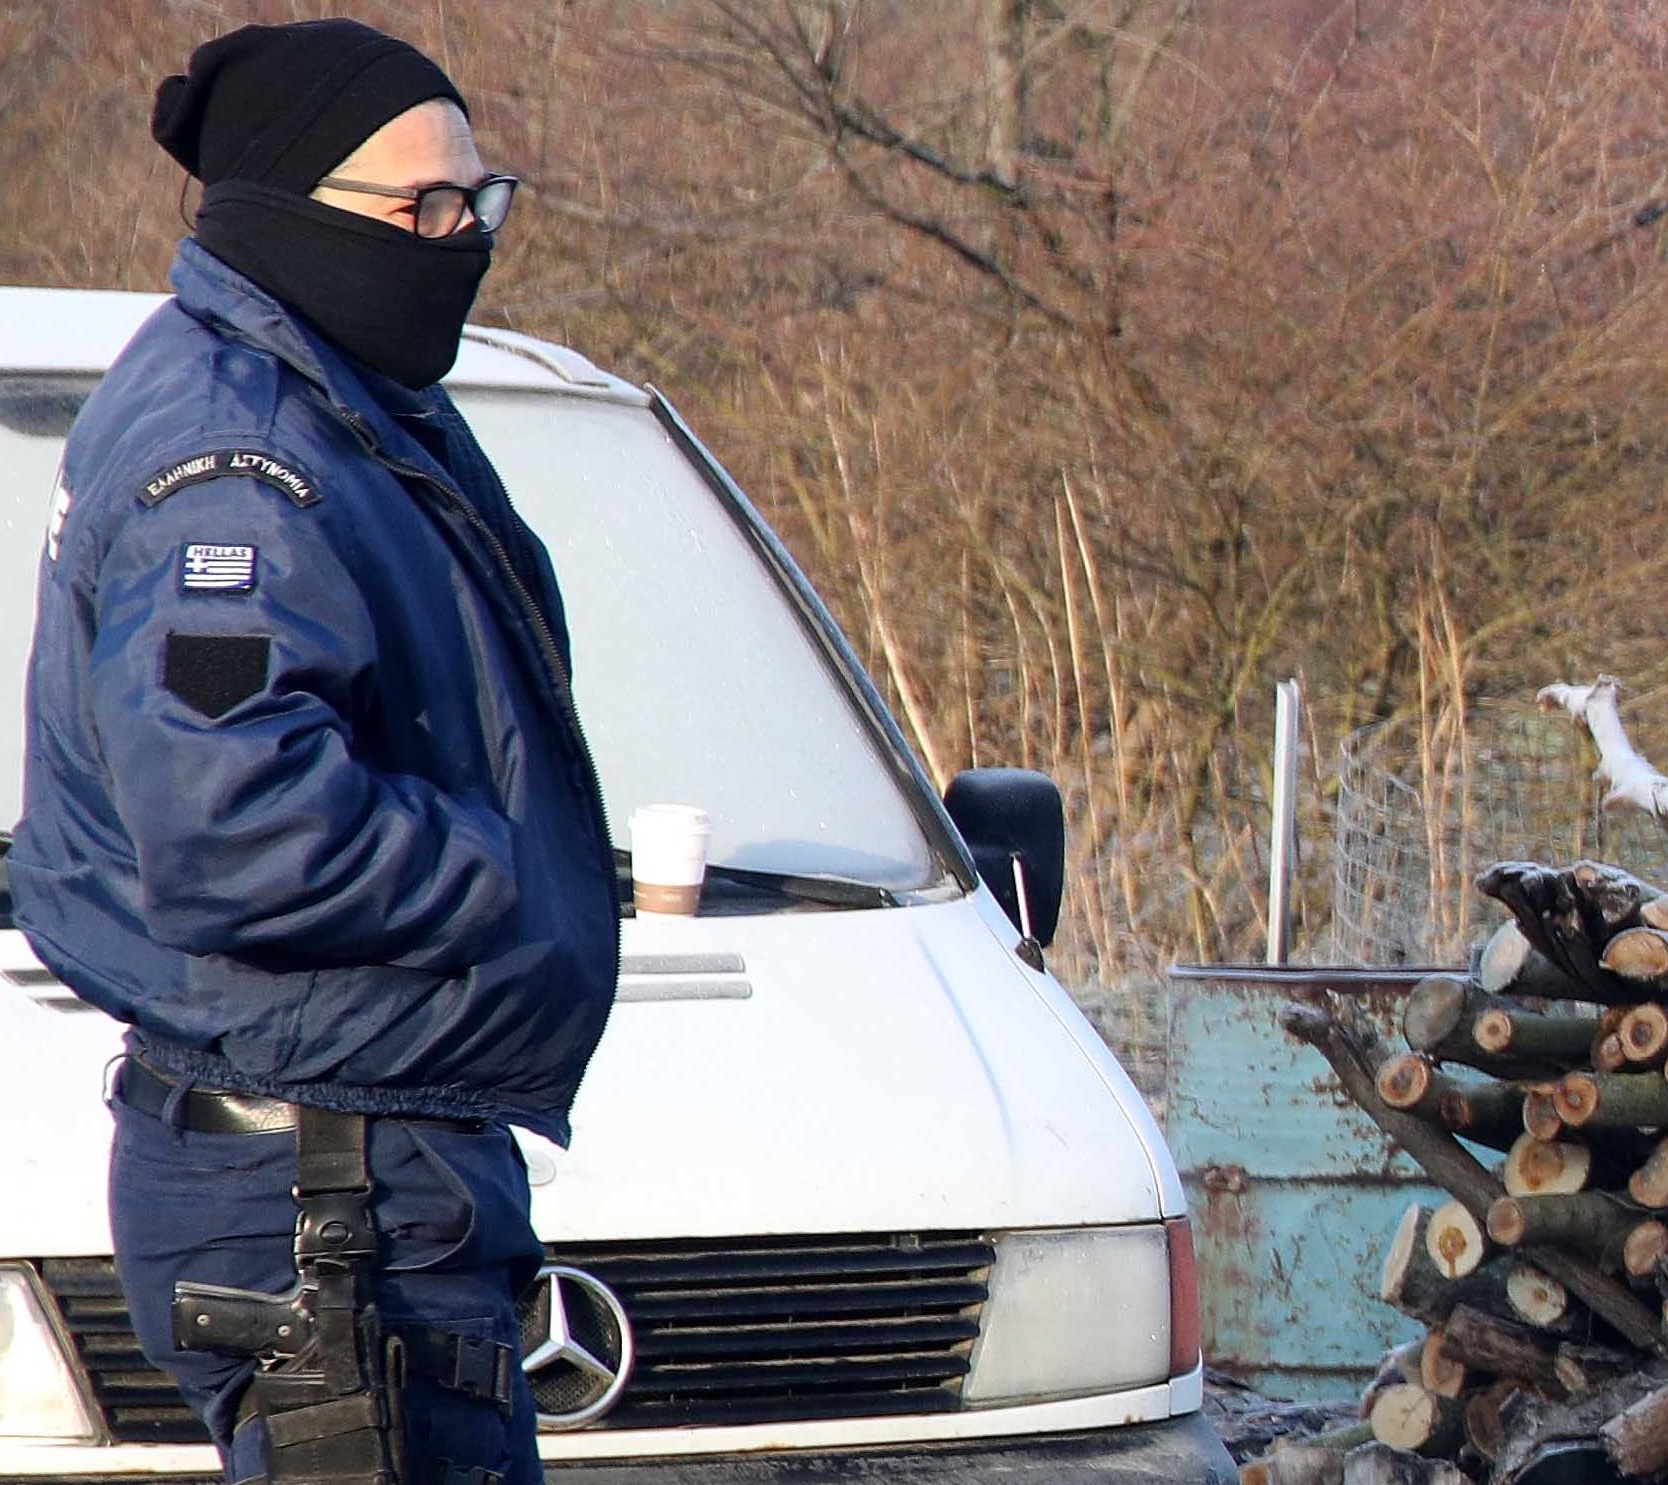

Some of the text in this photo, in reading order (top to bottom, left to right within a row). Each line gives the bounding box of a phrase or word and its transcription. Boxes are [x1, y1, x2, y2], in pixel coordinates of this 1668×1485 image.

[147, 451, 310, 498] ΕΛΛΗΝΙΚΗ ΑΣΤΥΝΟΜΙΑ
[193, 546, 247, 558] HELLAS
